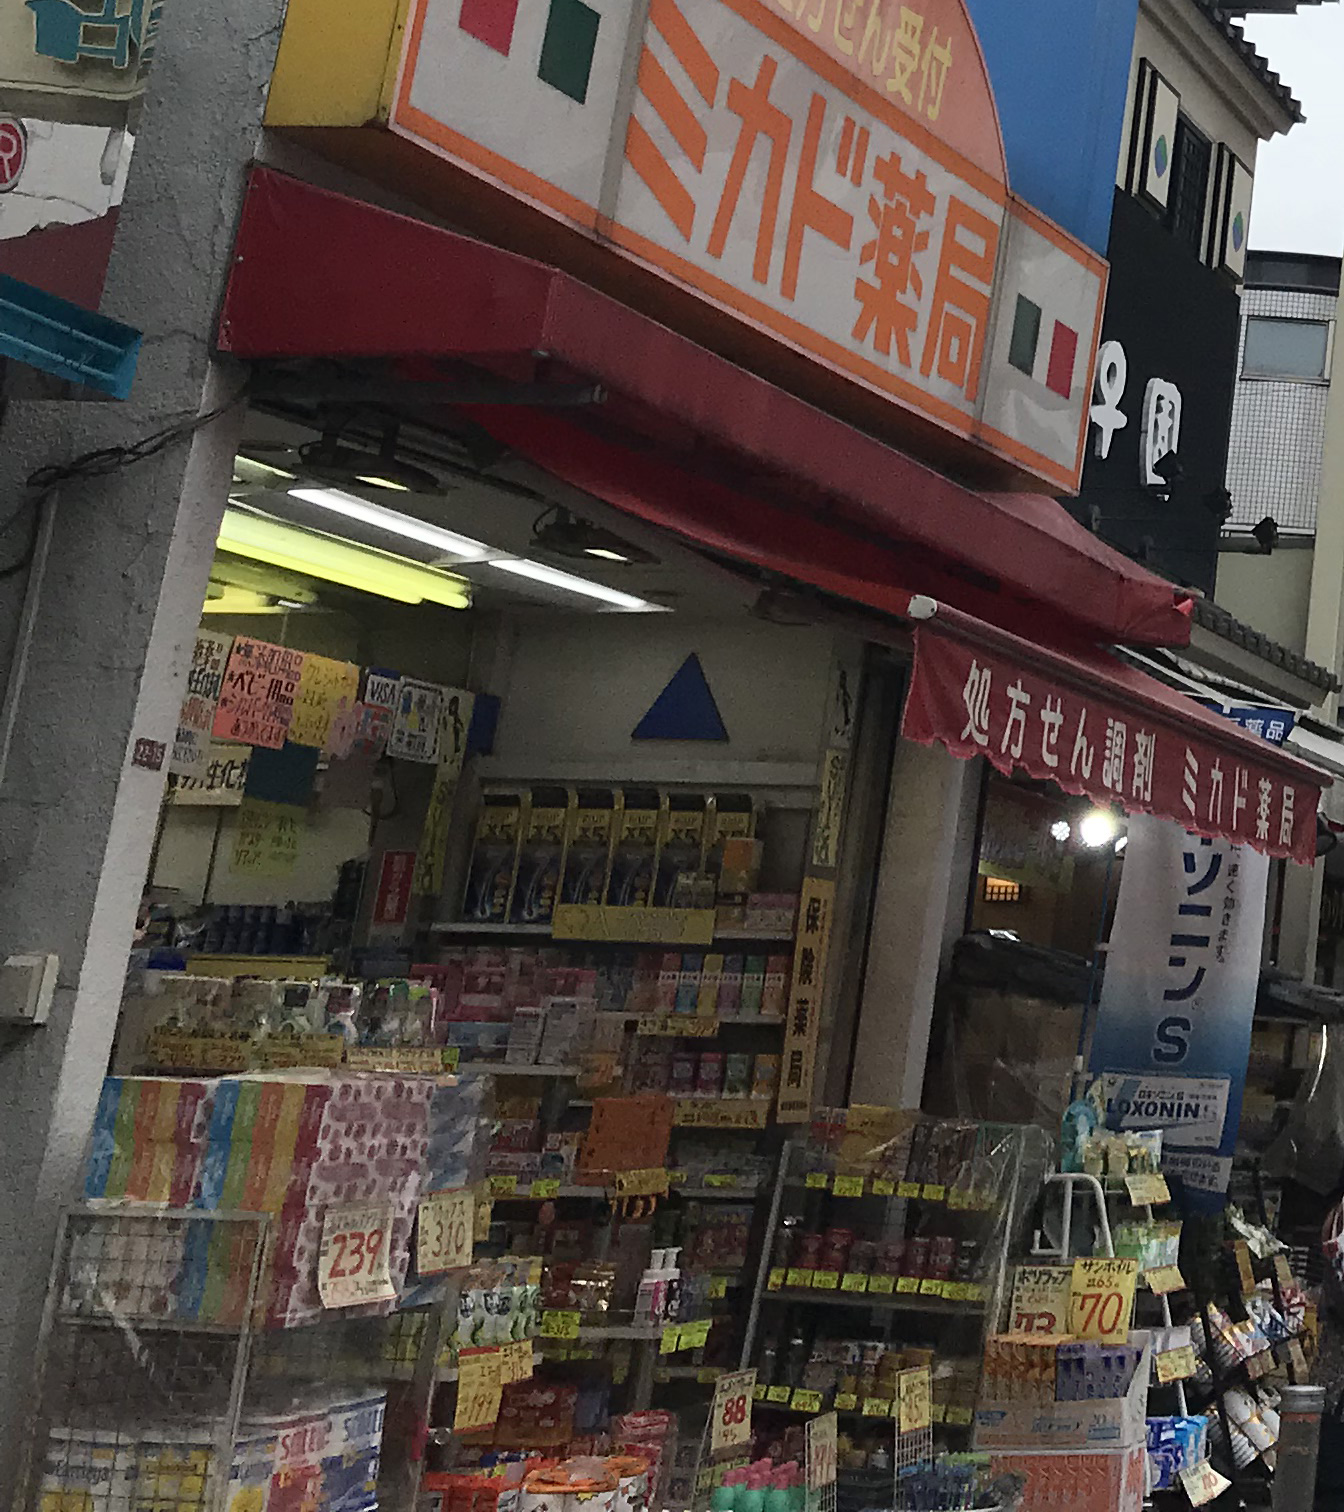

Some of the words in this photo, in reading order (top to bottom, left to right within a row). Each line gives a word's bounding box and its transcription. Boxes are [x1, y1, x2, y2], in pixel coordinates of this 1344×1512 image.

[370, 681, 395, 703] VISA
[1233, 717, 1285, 742] 薬品
[960, 659, 1157, 803] 処方せん調剤
[1182, 746, 1295, 847] ミカド薬局
[1106, 1097, 1201, 1120] LOXONIN
[328, 1229, 384, 1279] 239
[1079, 1292, 1124, 1335] 70
[722, 1394, 747, 1426] 88
